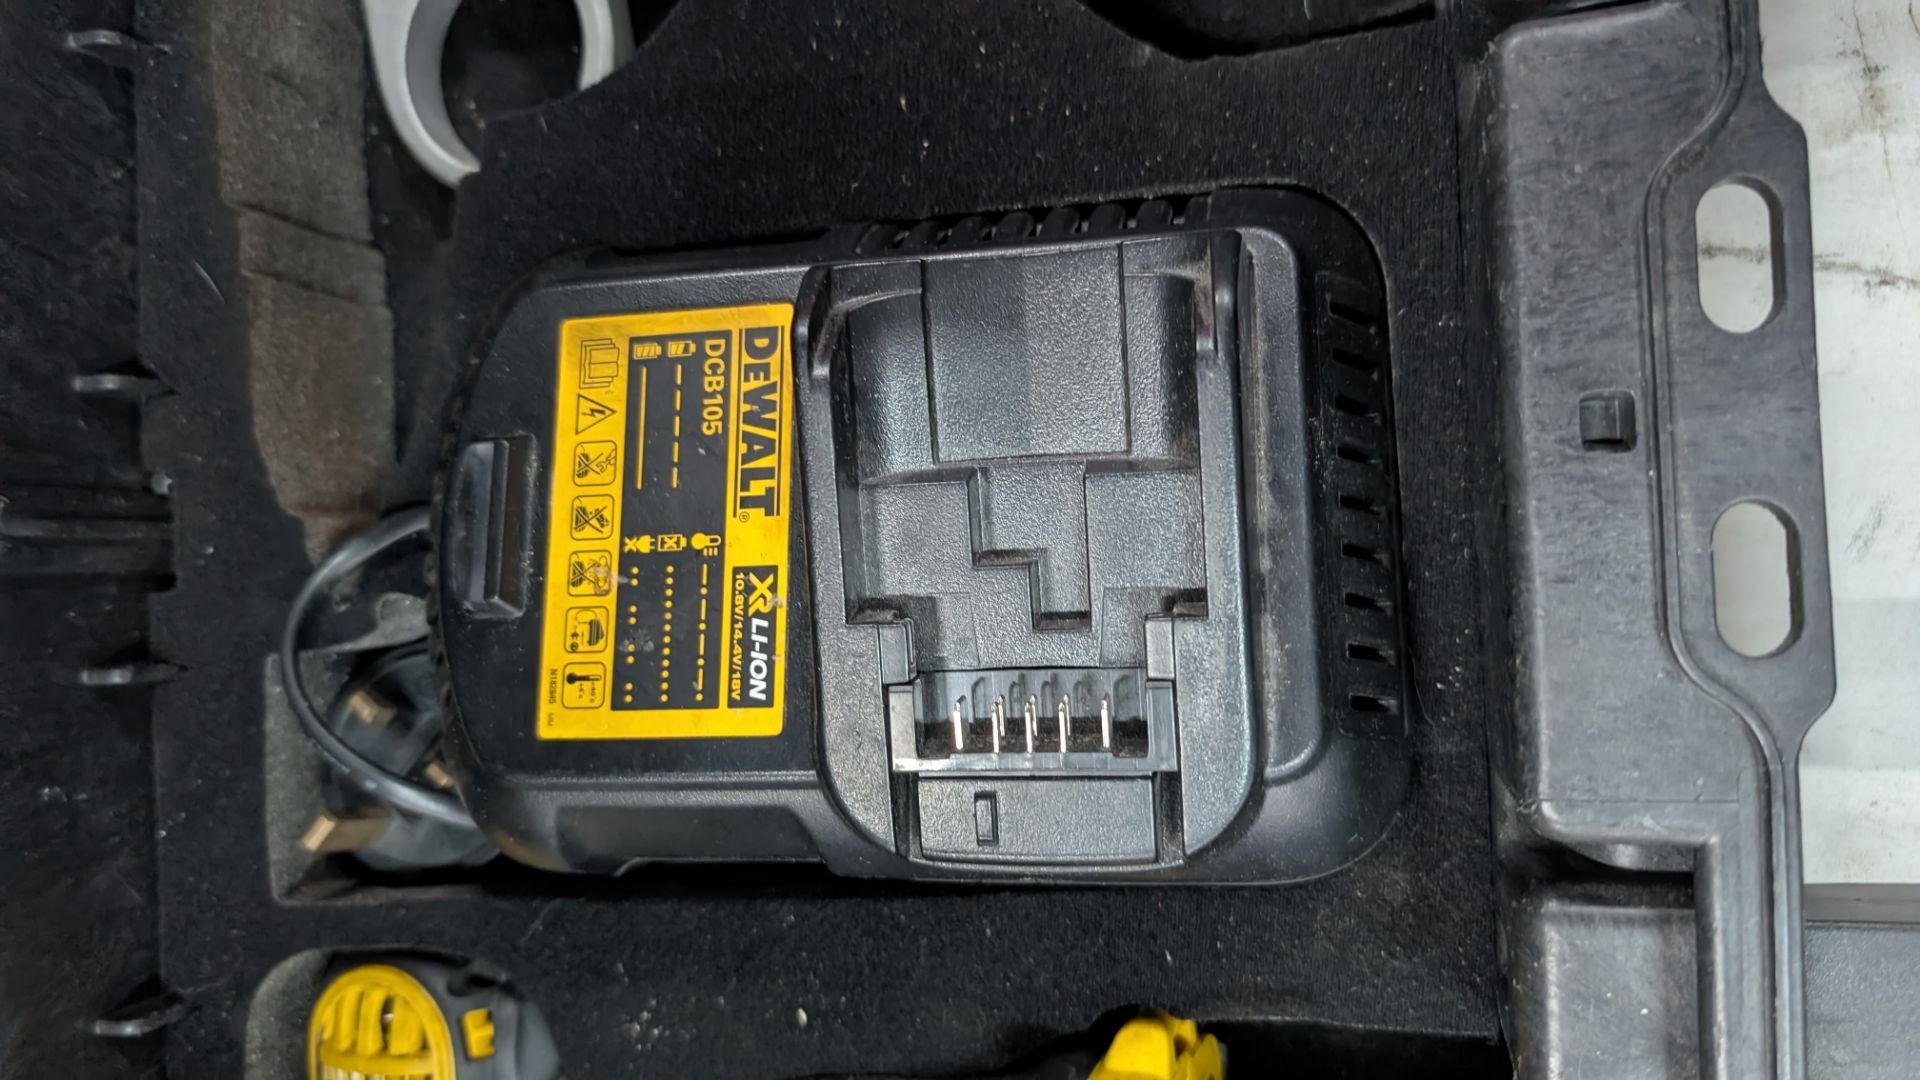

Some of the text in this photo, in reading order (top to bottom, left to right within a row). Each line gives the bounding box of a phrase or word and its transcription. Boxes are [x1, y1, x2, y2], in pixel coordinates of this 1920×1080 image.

[702, 338, 726, 436] DCB105
[731, 572, 745, 701] 10.8V/14.4V/18V
[748, 572, 775, 701] XR LI-ION
